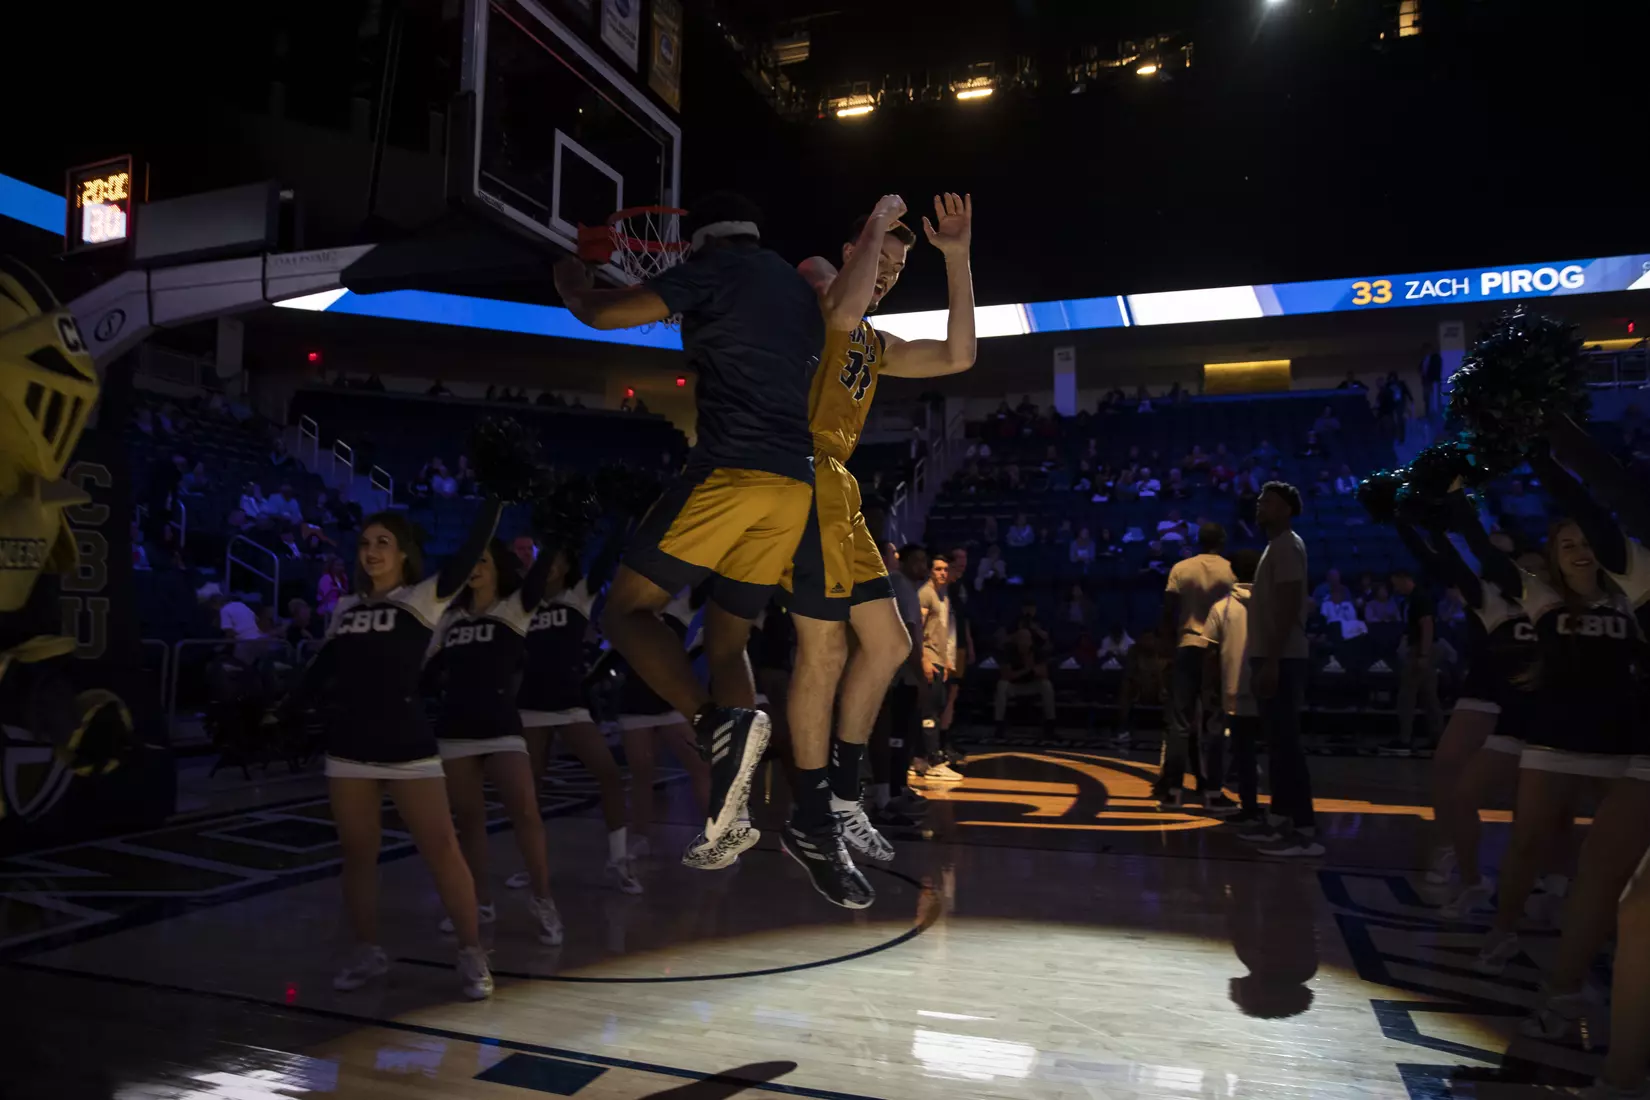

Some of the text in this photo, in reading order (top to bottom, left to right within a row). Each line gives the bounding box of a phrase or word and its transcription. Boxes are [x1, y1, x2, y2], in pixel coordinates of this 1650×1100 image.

[1351, 265, 1585, 306] 33 ZACH PIROG
[59, 461, 111, 659] CBU
[336, 608, 398, 635] CBU
[528, 608, 568, 631] CBU
[1556, 613, 1627, 640] CBU
[445, 623, 496, 647] CBU
